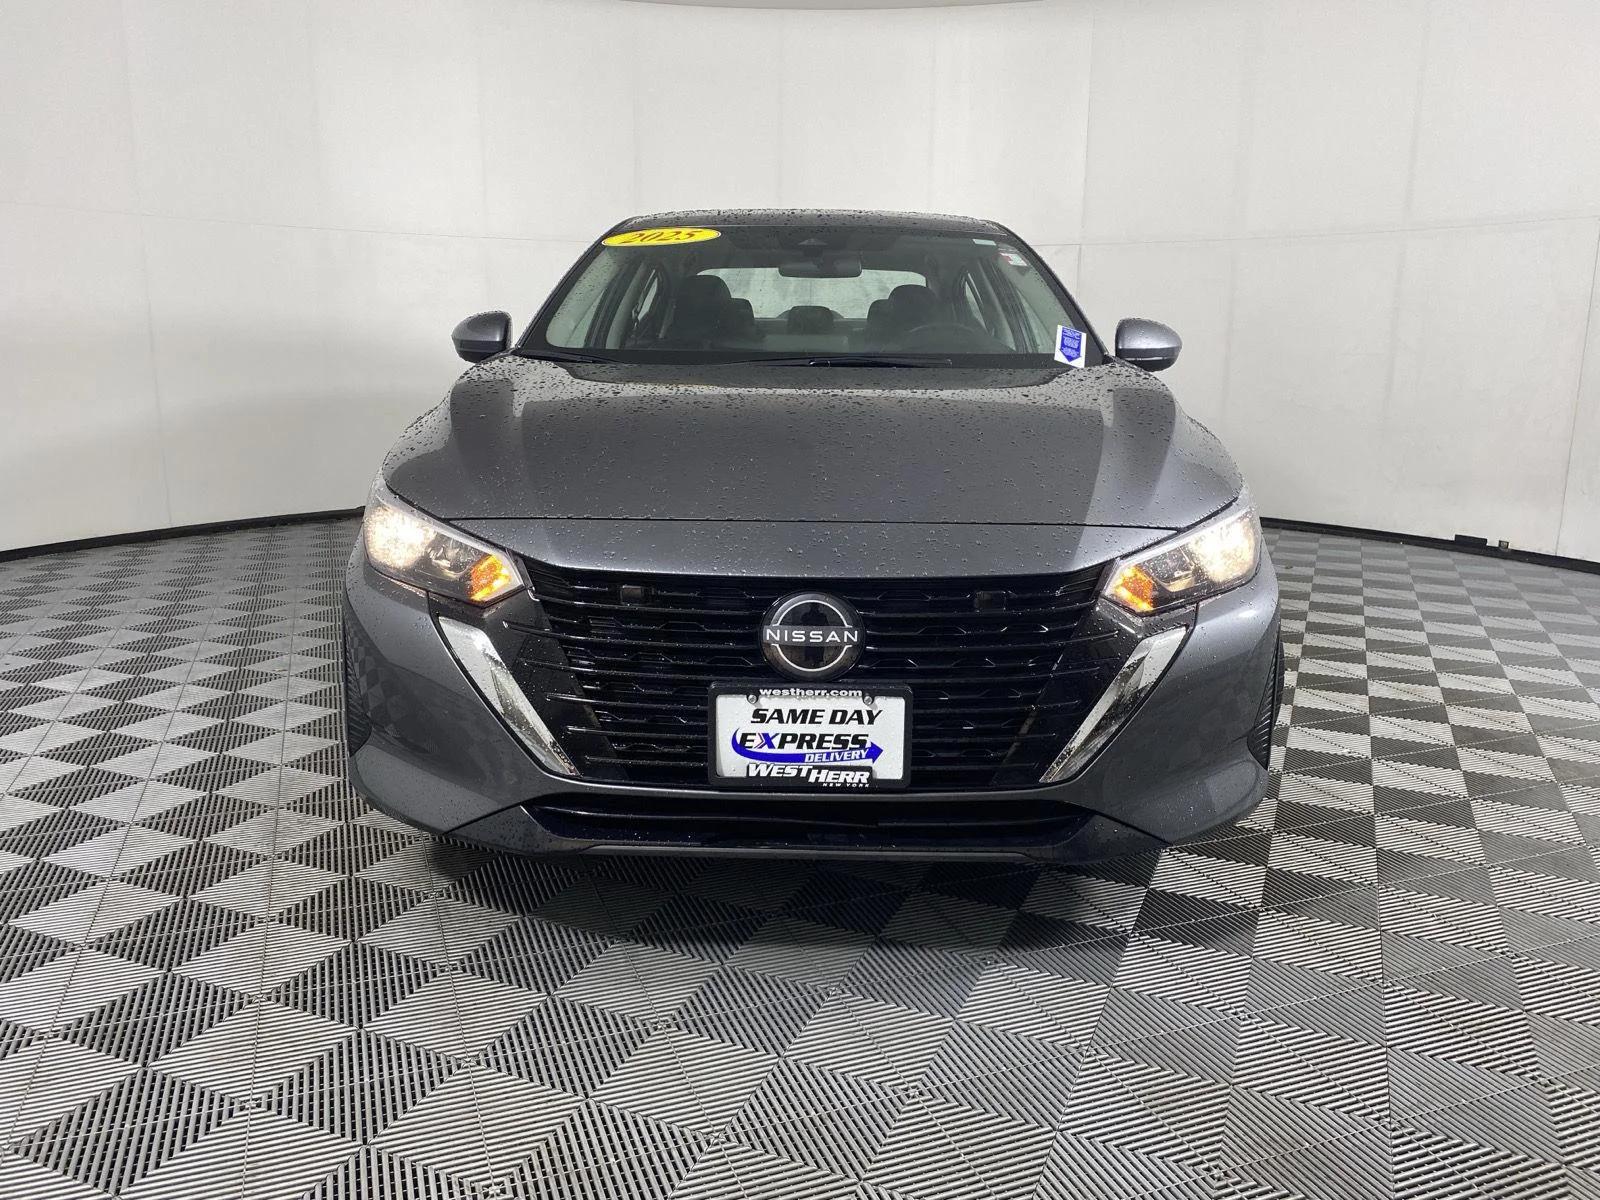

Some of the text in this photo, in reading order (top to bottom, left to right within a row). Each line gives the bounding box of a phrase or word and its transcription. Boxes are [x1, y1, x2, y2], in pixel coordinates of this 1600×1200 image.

[617, 230, 704, 244] 2025
[766, 628, 858, 643] NISSAN
[759, 688, 862, 697] westherr.com
[751, 708, 883, 725] SAME DAY
[739, 732, 869, 750] EXPRESS
[804, 749, 868, 763] DELIVERY
